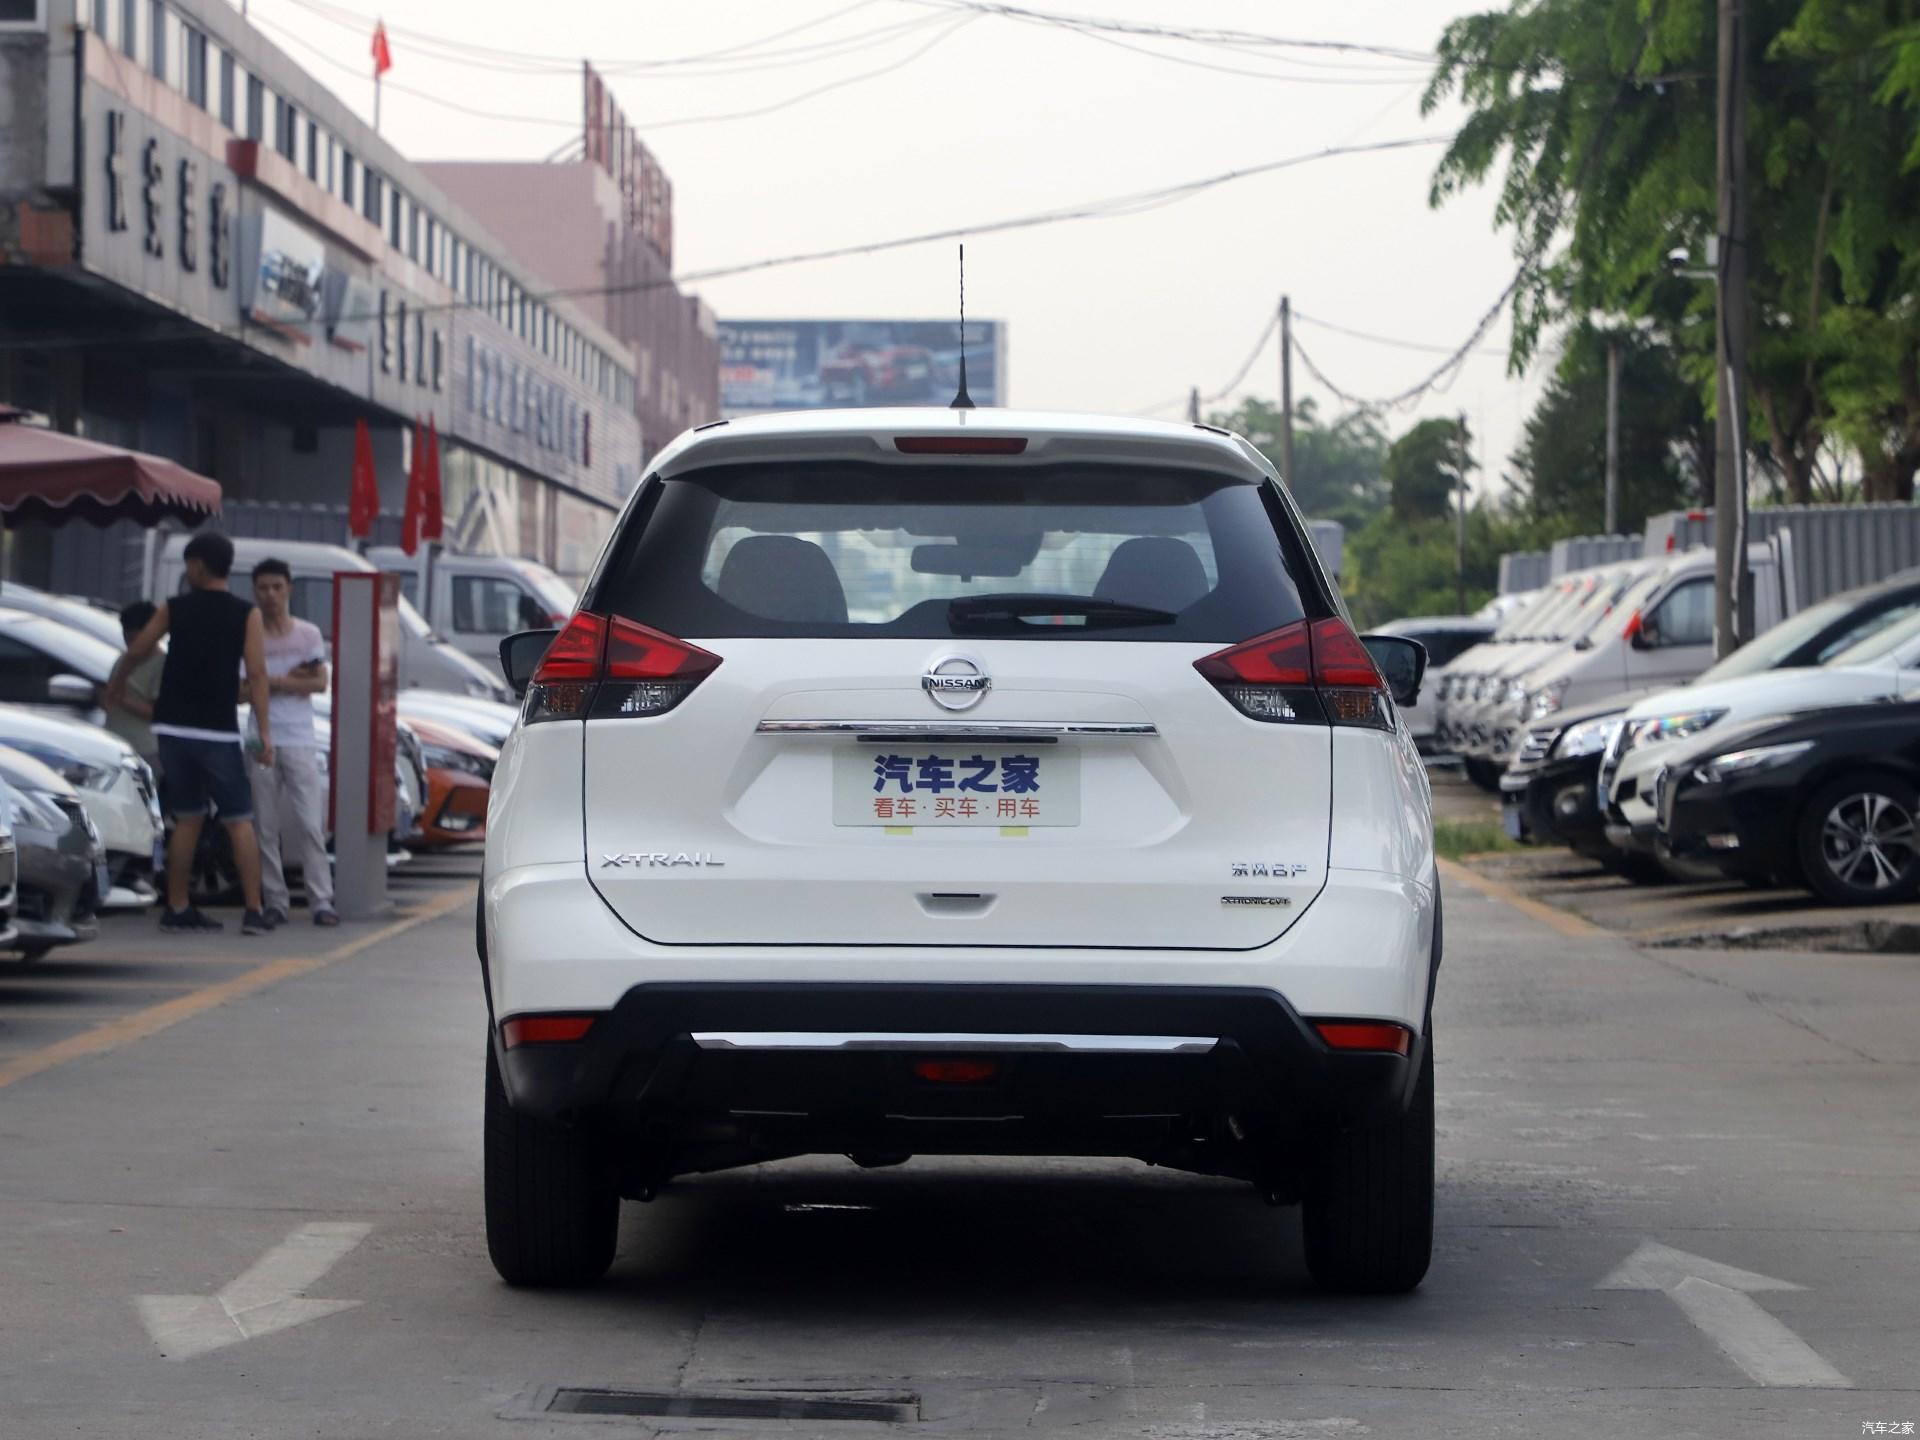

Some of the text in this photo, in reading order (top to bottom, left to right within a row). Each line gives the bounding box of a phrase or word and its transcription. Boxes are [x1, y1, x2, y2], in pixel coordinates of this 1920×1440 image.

[928, 678, 984, 690] NISSAN
[873, 754, 1040, 794] 汽车之家
[873, 797, 1041, 818] 看车·买车·用车
[600, 852, 726, 869] X-TRAIL
[1231, 863, 1307, 878] 东风日产
